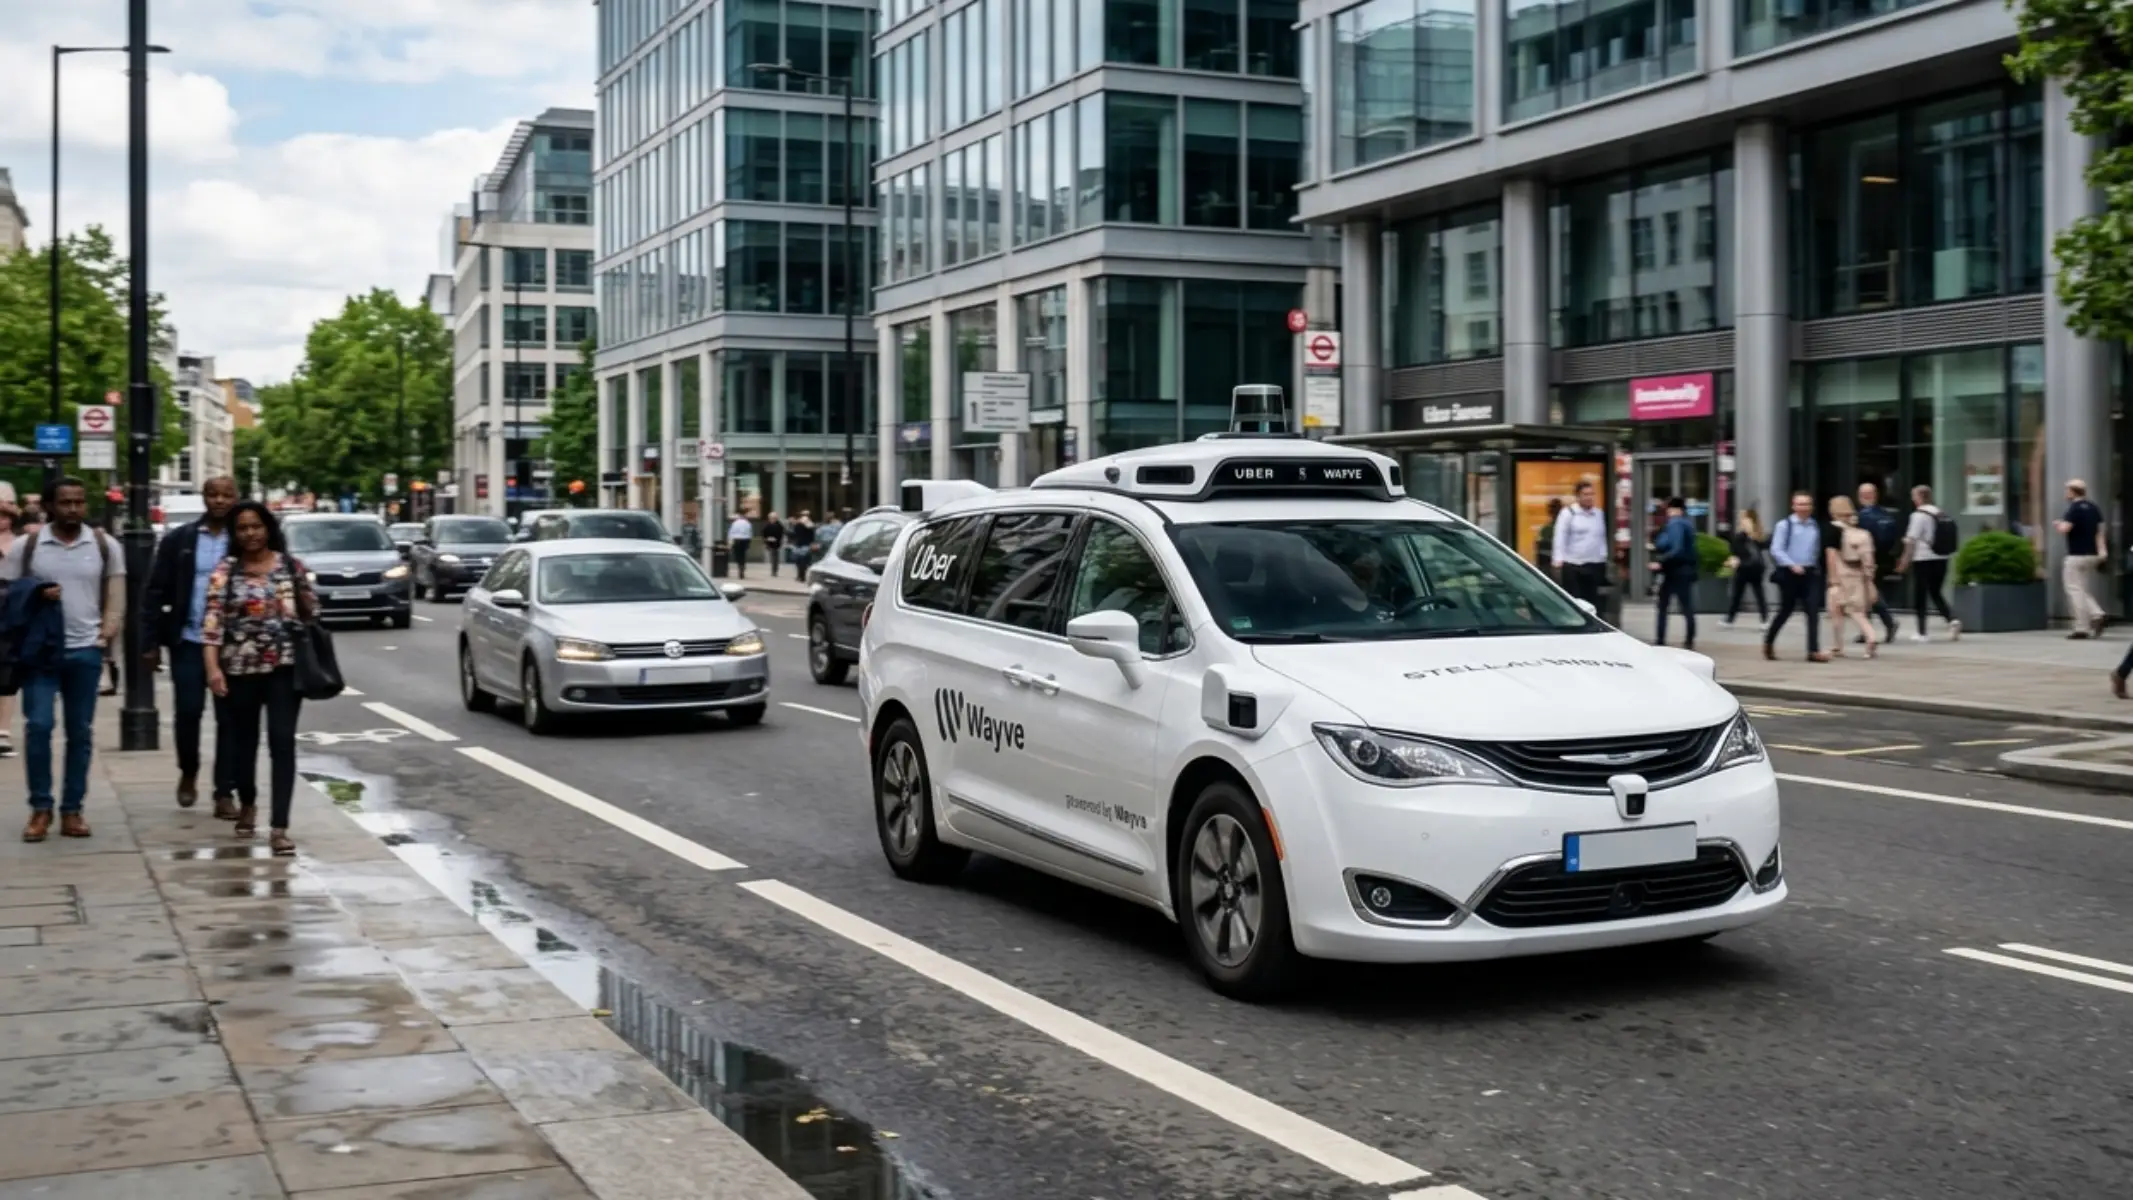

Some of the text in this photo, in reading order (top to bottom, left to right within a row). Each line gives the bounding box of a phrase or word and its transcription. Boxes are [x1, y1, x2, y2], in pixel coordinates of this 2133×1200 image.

[1234, 468, 1274, 479] UBER
[910, 544, 957, 581] Uber
[966, 702, 1025, 753] Wayve
